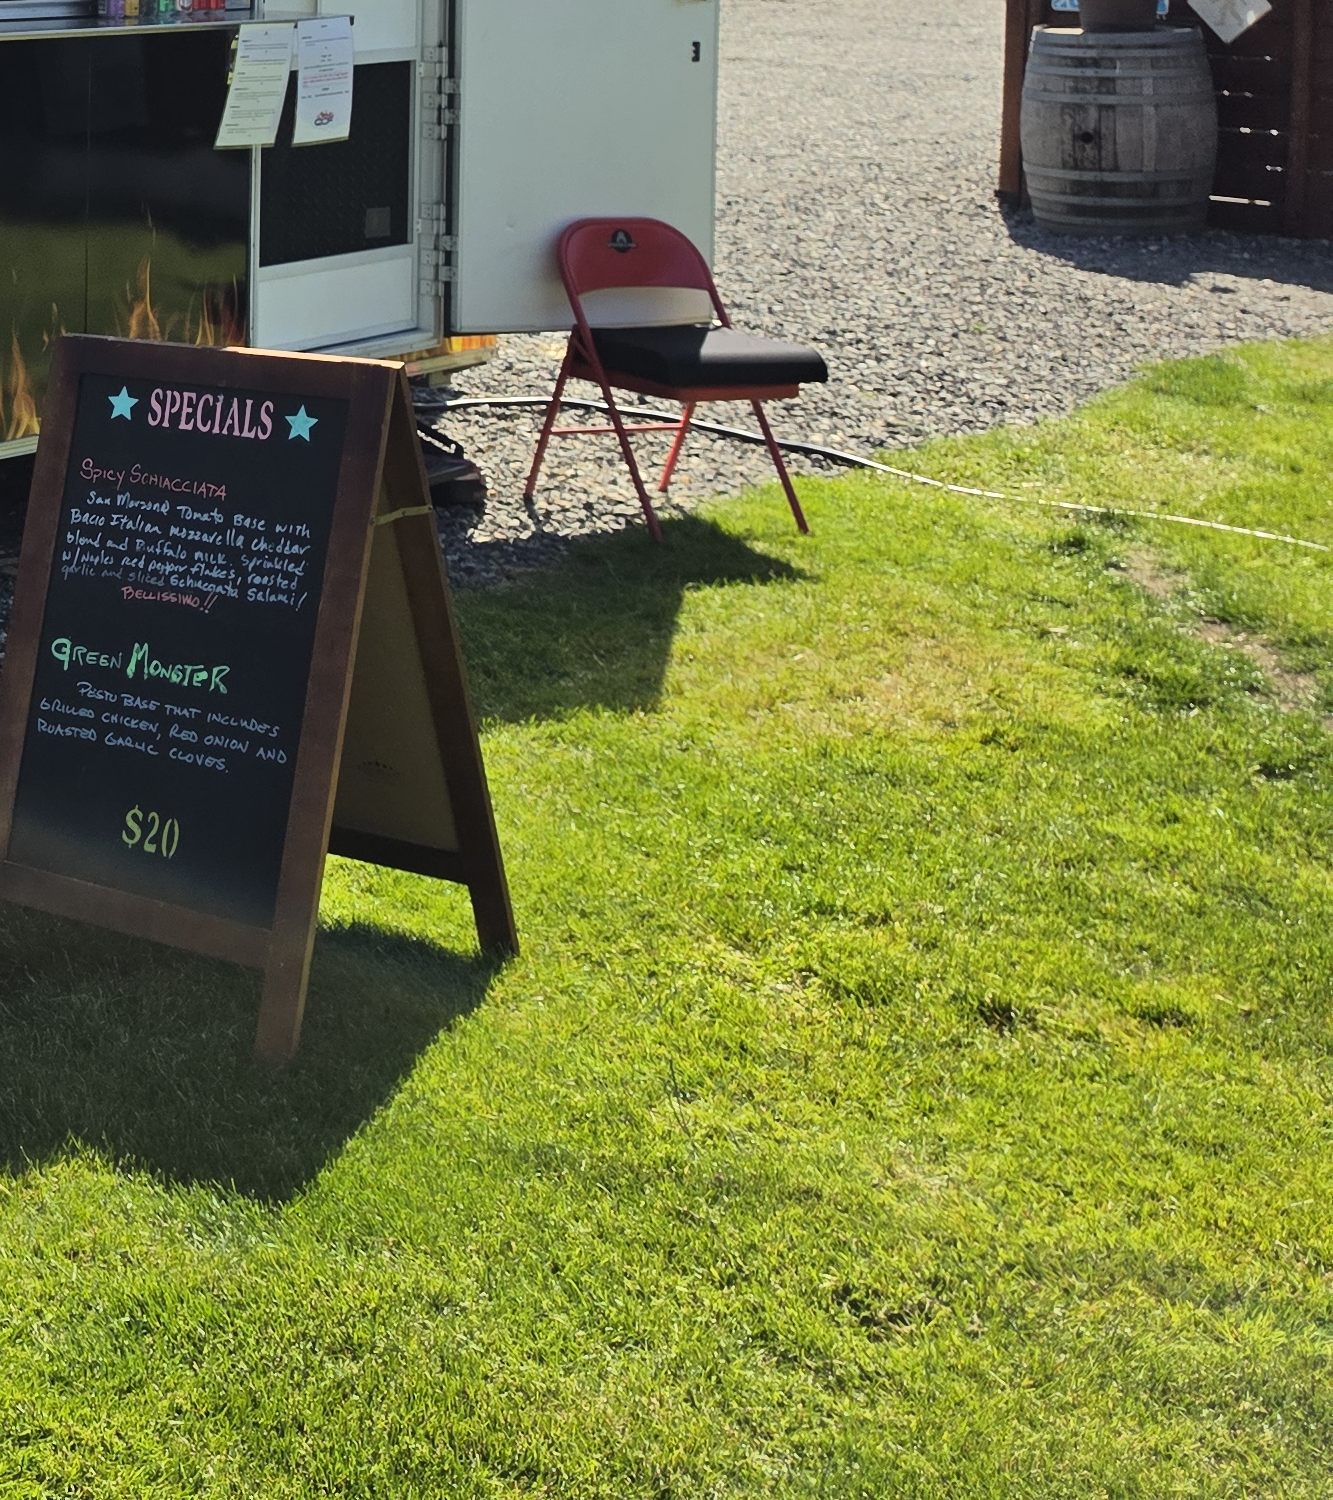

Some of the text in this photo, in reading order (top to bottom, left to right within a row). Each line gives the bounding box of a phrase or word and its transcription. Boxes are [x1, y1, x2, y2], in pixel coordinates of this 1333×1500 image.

[147, 388, 274, 440] SPECIALS
[109, 514, 162, 535] Italian
[176, 505, 224, 524] Tomato
[51, 637, 123, 671] GREEN
[120, 693, 161, 711] BASE
[164, 704, 202, 719] THAT
[203, 735, 250, 754] ONION
[255, 747, 288, 764] AND
[121, 804, 181, 859] $20
